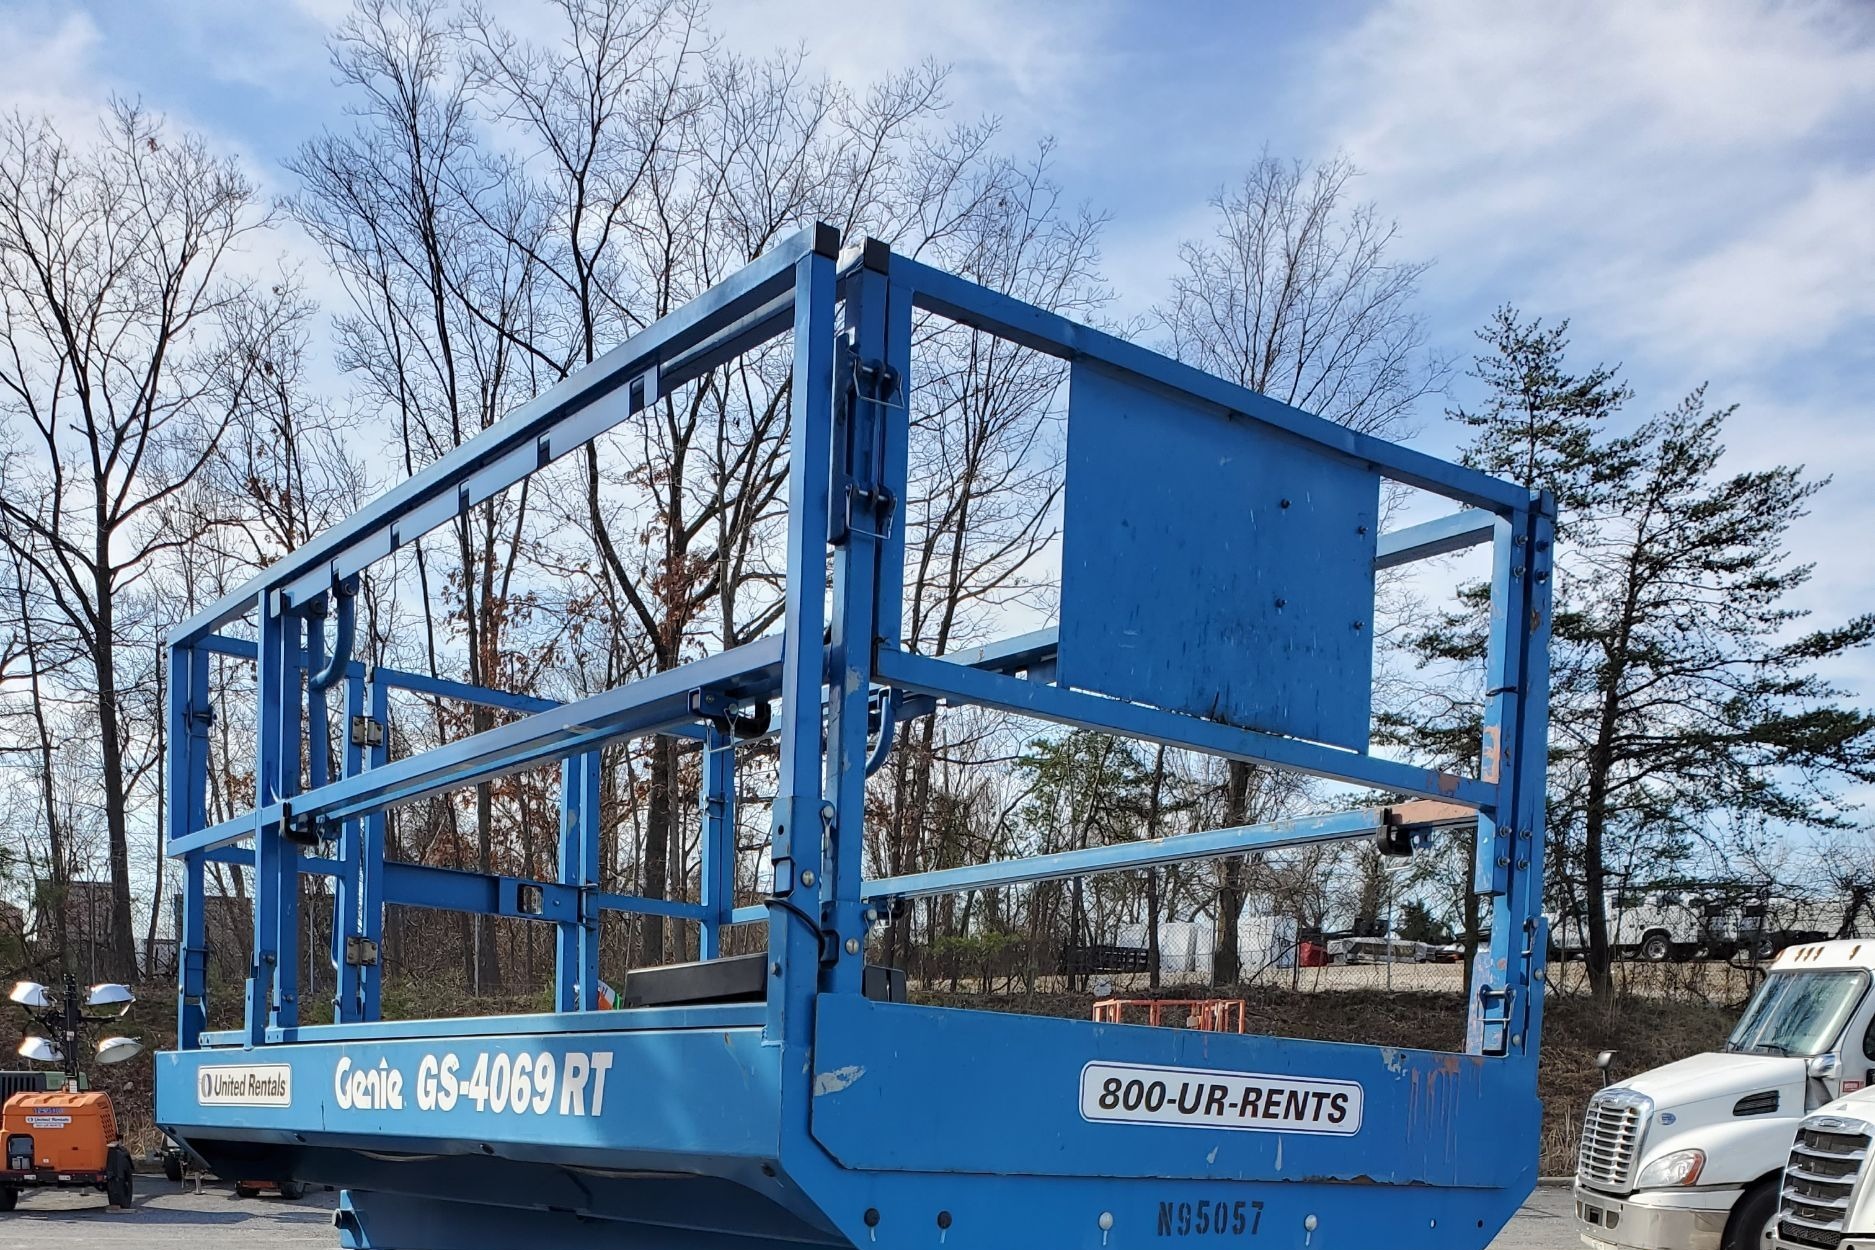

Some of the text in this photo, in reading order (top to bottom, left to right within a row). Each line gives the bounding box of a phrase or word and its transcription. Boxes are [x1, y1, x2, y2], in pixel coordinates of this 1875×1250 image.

[214, 1071, 287, 1098] United Rentals
[335, 1051, 614, 1117] Genie GS-4069 RT
[1098, 1077, 1350, 1124] 800-UR-RENTS
[1157, 1200, 1265, 1237] N95057
